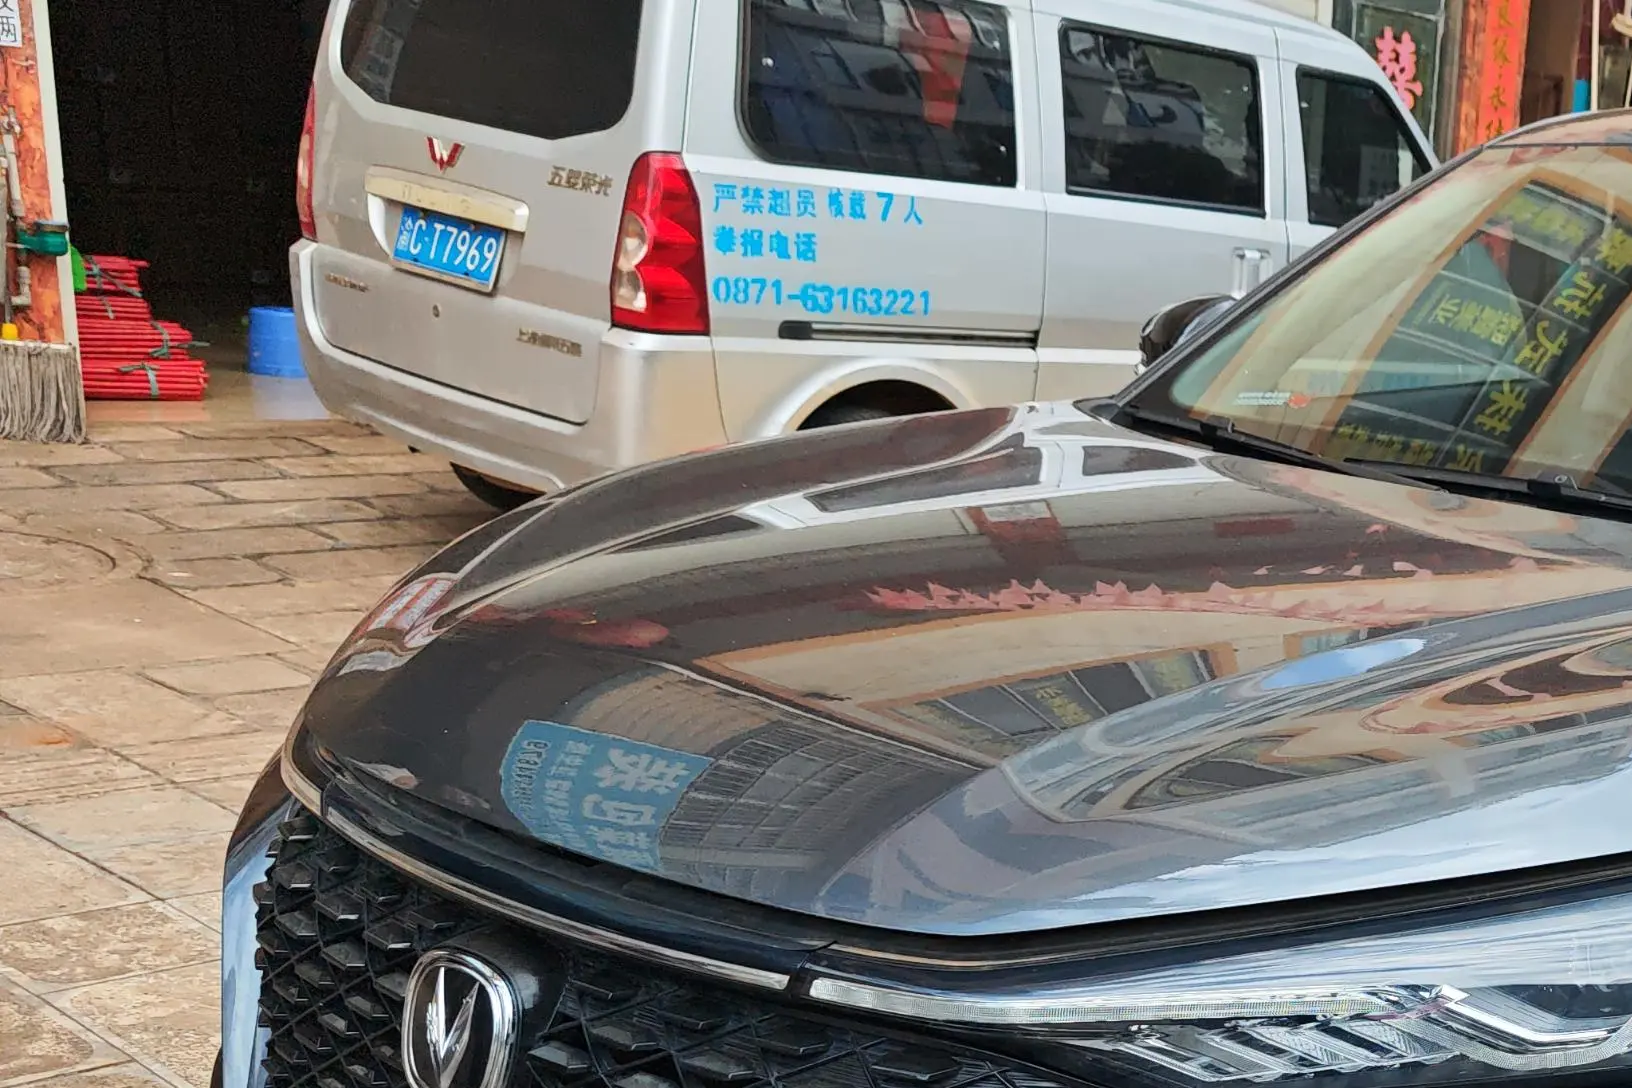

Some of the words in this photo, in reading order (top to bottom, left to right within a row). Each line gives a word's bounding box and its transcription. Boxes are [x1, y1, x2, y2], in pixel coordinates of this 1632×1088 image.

[713, 183, 817, 218] 严禁超员
[713, 224, 818, 262] 举报电话
[712, 276, 931, 316] 0871-63163221
